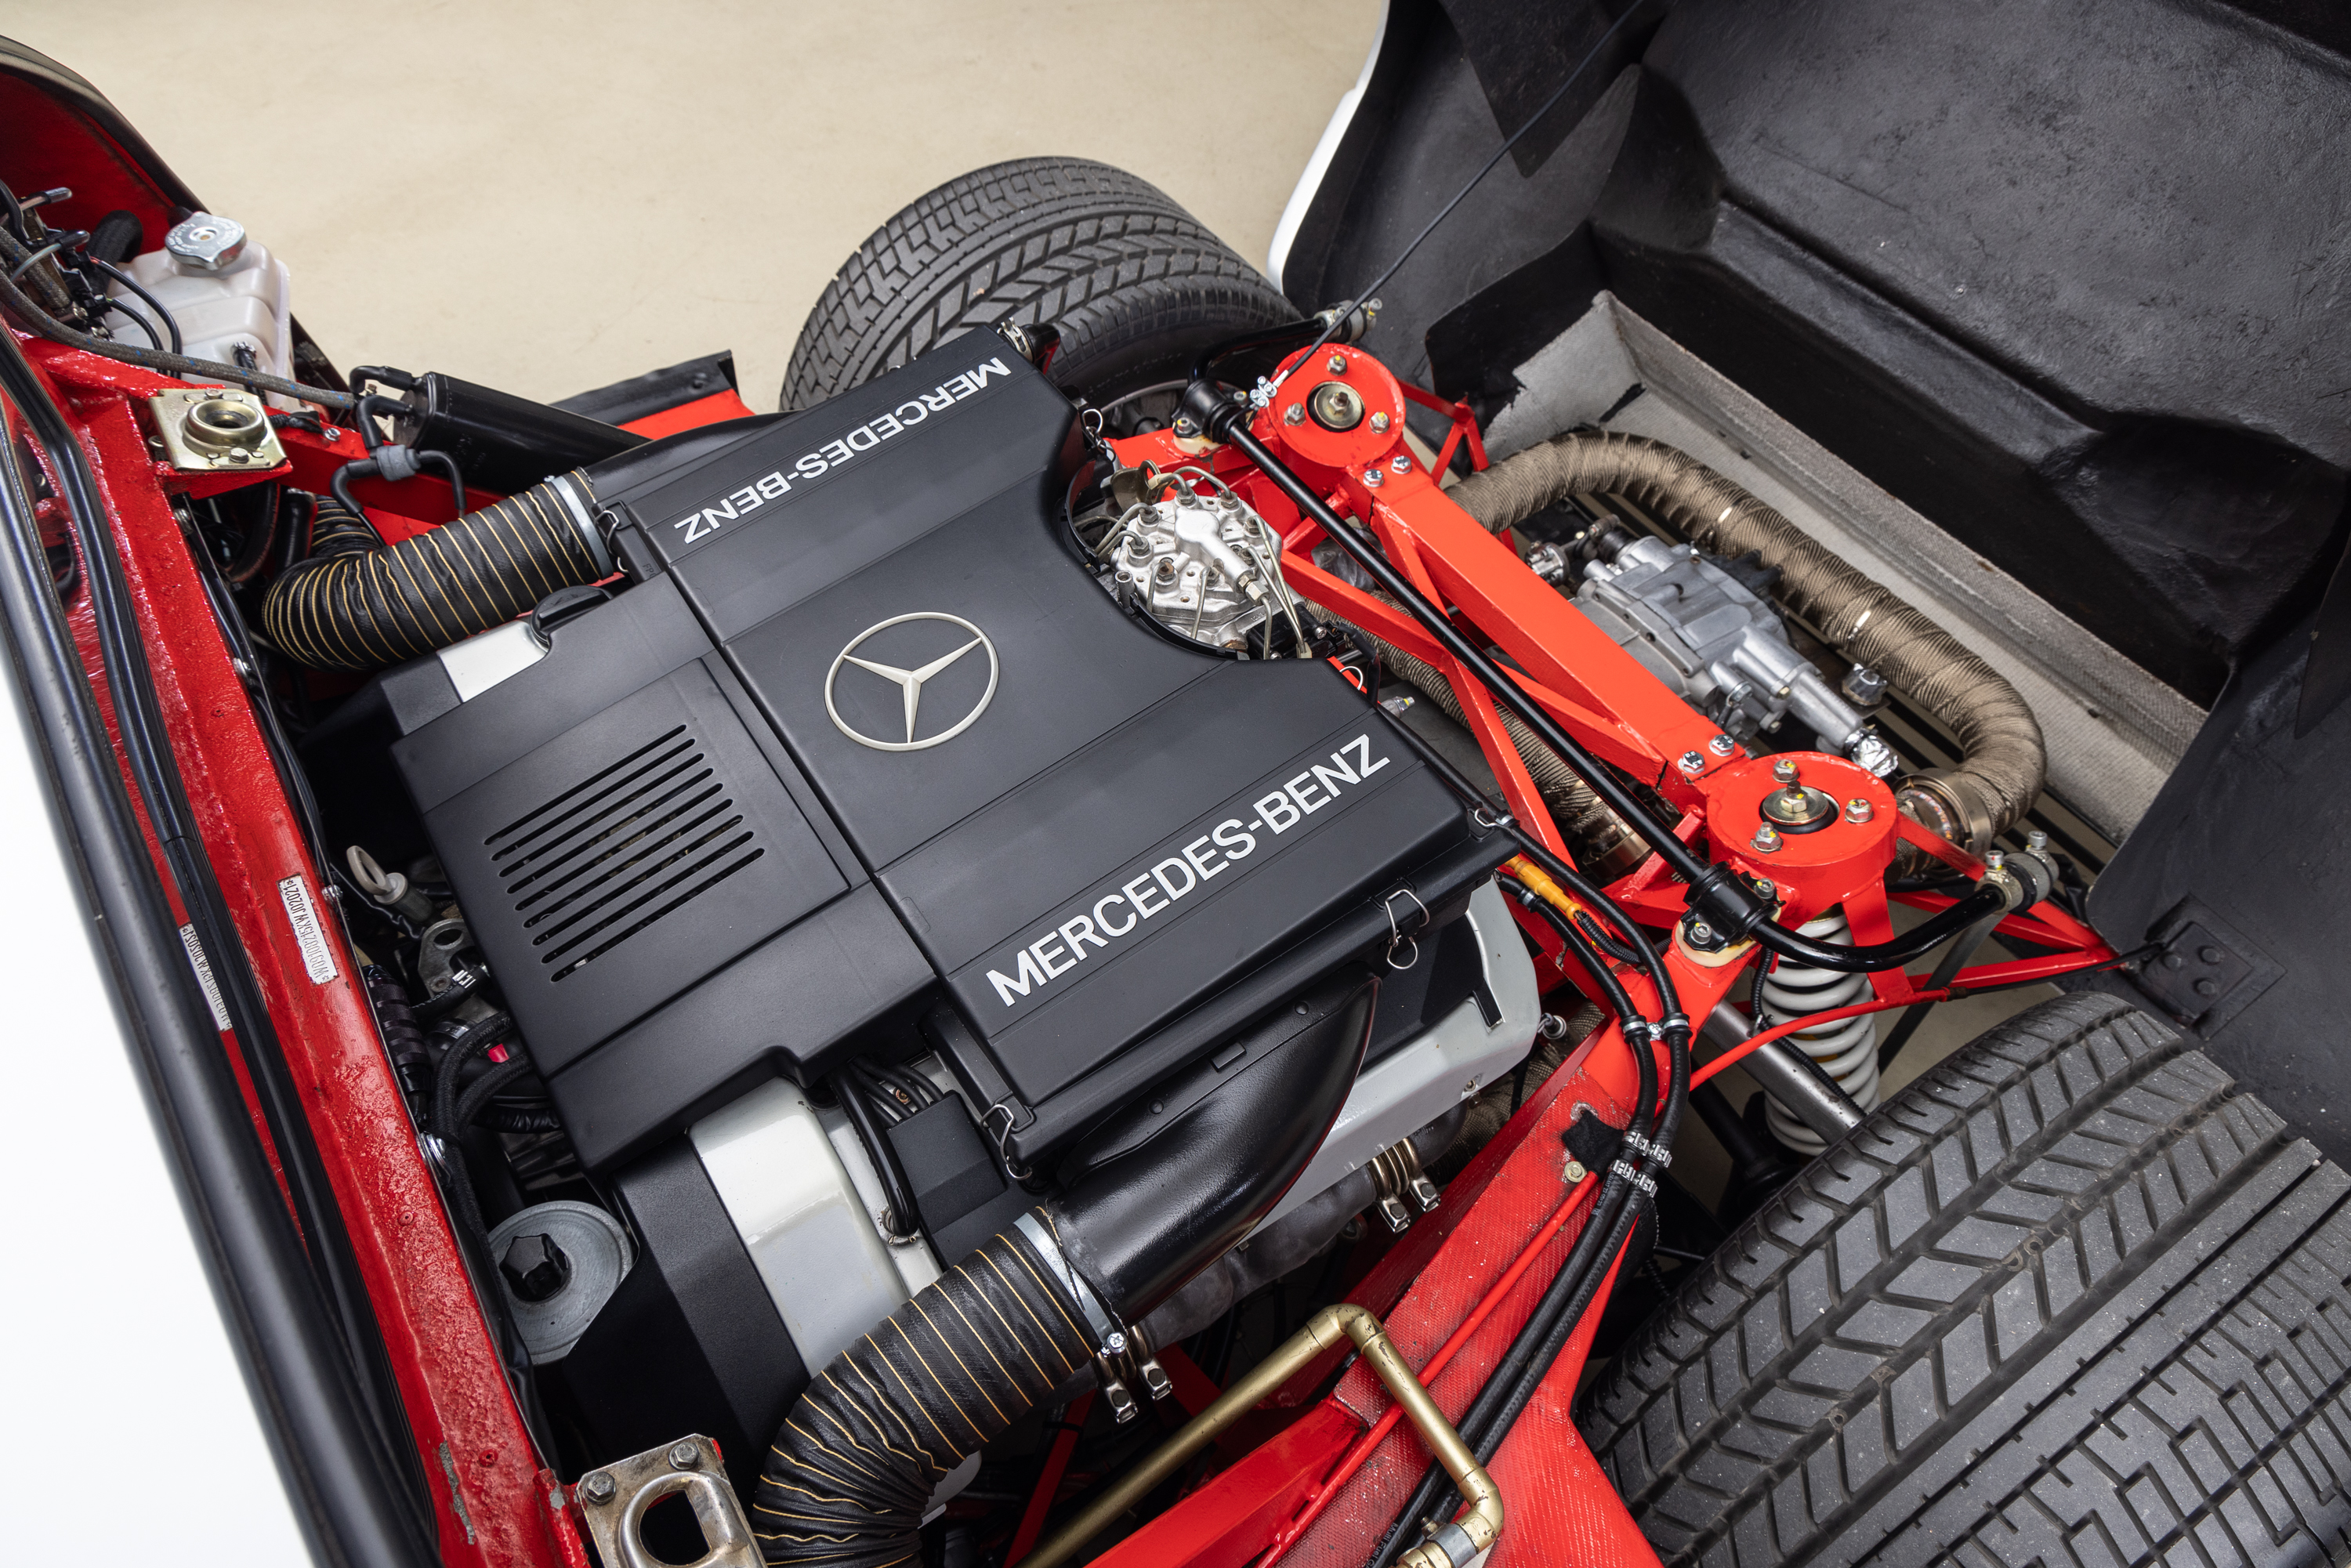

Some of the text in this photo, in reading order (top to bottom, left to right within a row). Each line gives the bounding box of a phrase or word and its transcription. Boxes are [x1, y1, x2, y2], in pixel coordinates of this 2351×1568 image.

[674, 357, 1011, 544] MERCEDES-BENZ
[986, 734, 1390, 1006] MERCEDES-BENZ
[1372, 1541, 1387, 1559] Fuel
[1384, 1522, 1399, 1541] Multi
